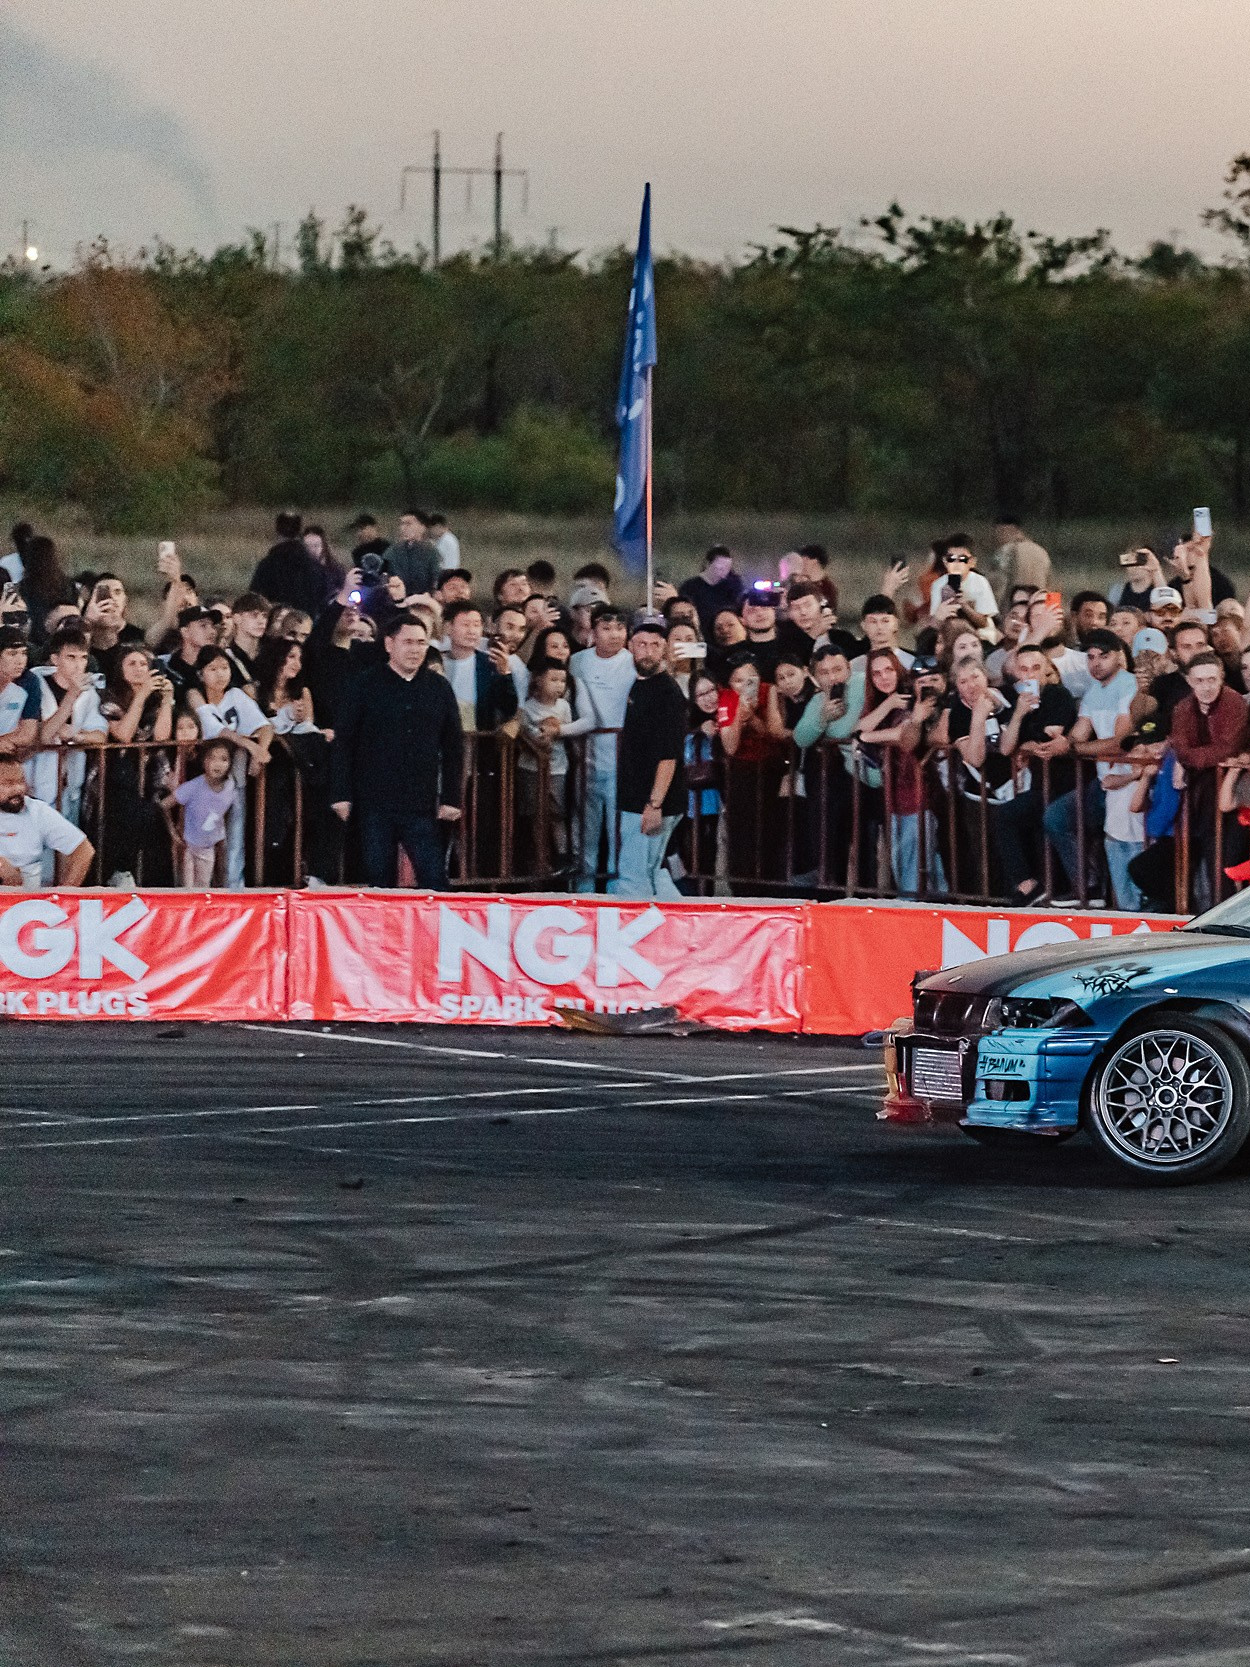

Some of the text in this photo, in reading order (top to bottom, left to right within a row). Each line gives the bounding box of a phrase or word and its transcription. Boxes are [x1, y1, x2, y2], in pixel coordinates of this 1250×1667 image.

[438, 903, 666, 989] NGK
[37, 991, 150, 1017] PLUGS
[439, 994, 549, 1020] SPARK
